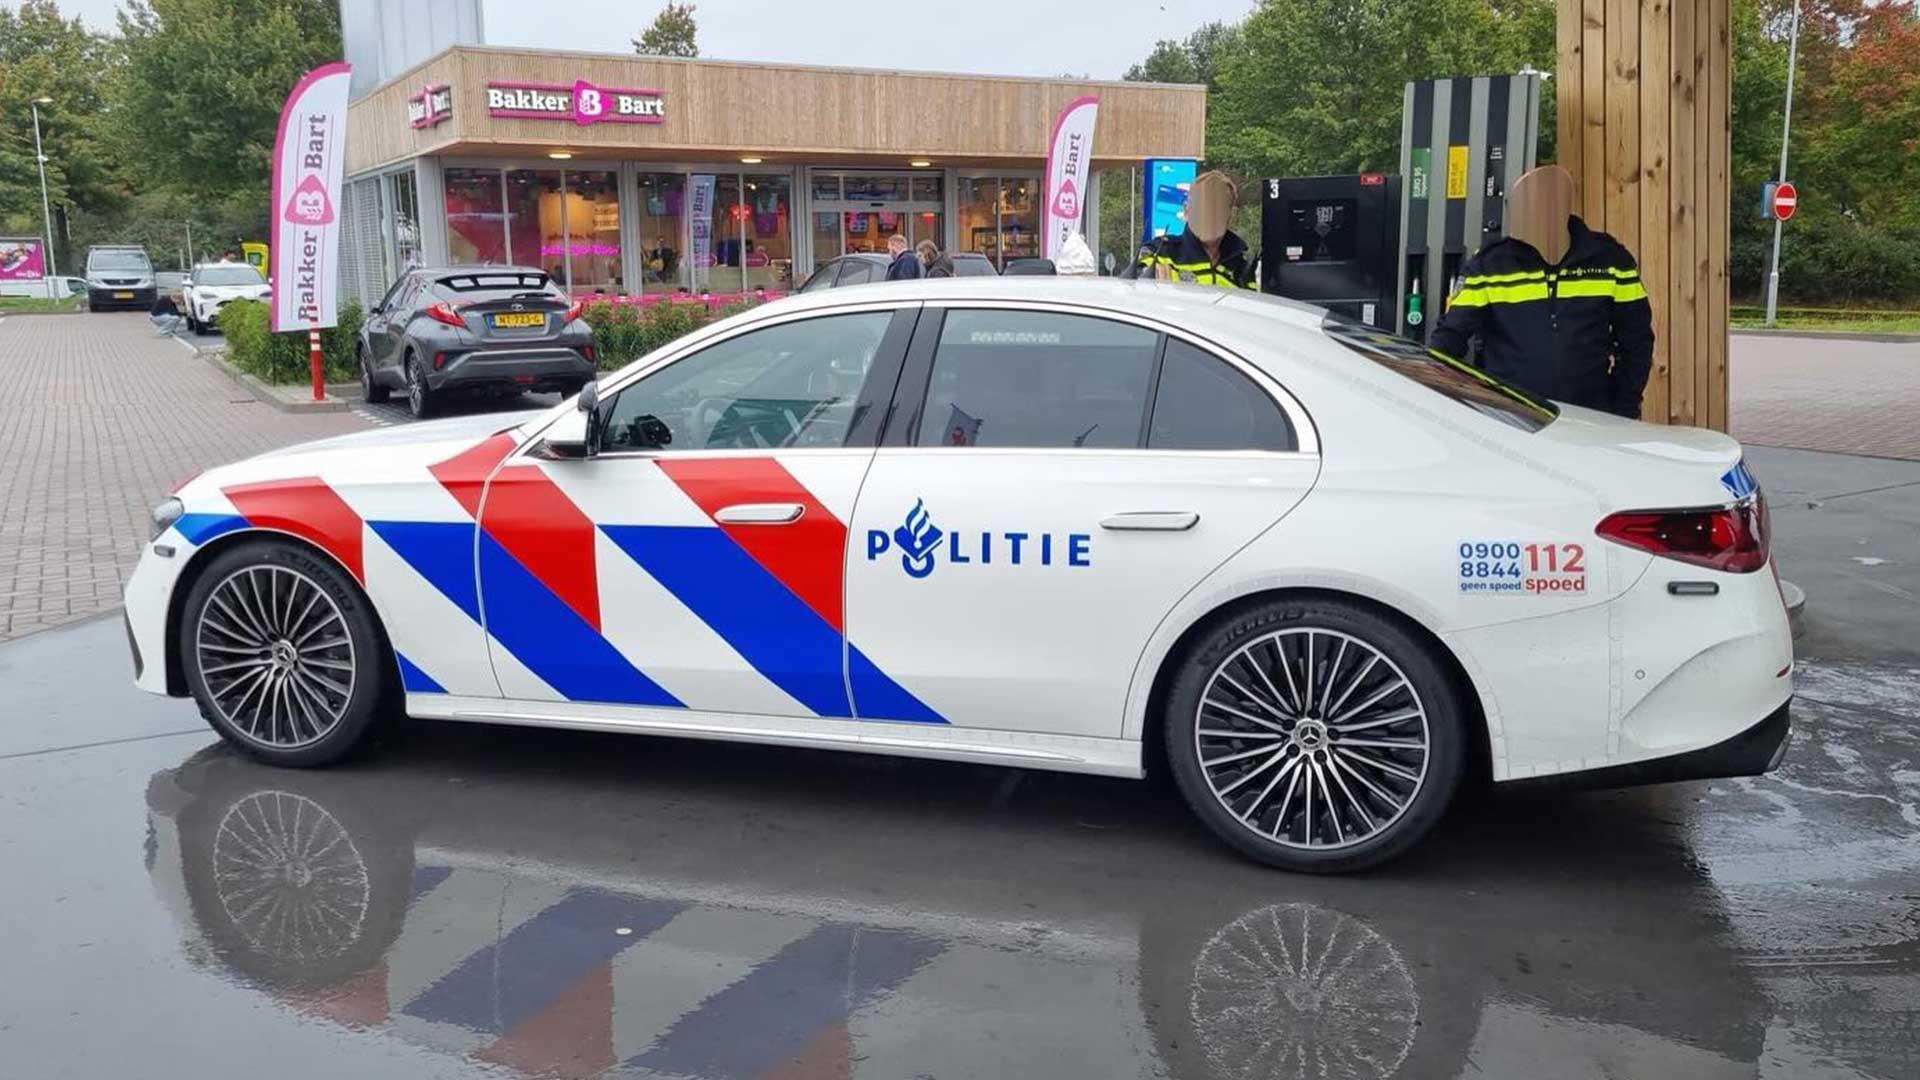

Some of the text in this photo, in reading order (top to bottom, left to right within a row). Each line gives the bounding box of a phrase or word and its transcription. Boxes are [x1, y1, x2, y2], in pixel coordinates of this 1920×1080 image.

[488, 89, 568, 111] Bakker
[619, 96, 664, 115] Bart
[304, 114, 326, 170] Bart
[1065, 132, 1082, 177] Bart
[1269, 182, 1280, 199] 3
[867, 497, 1092, 578] POLITIE
[1460, 543, 1520, 559] 0900
[1525, 544, 1585, 572] 112
[1460, 562, 1521, 578] 8844
[1460, 581, 1521, 592] geen spoed
[1525, 576, 1585, 594] spoed
